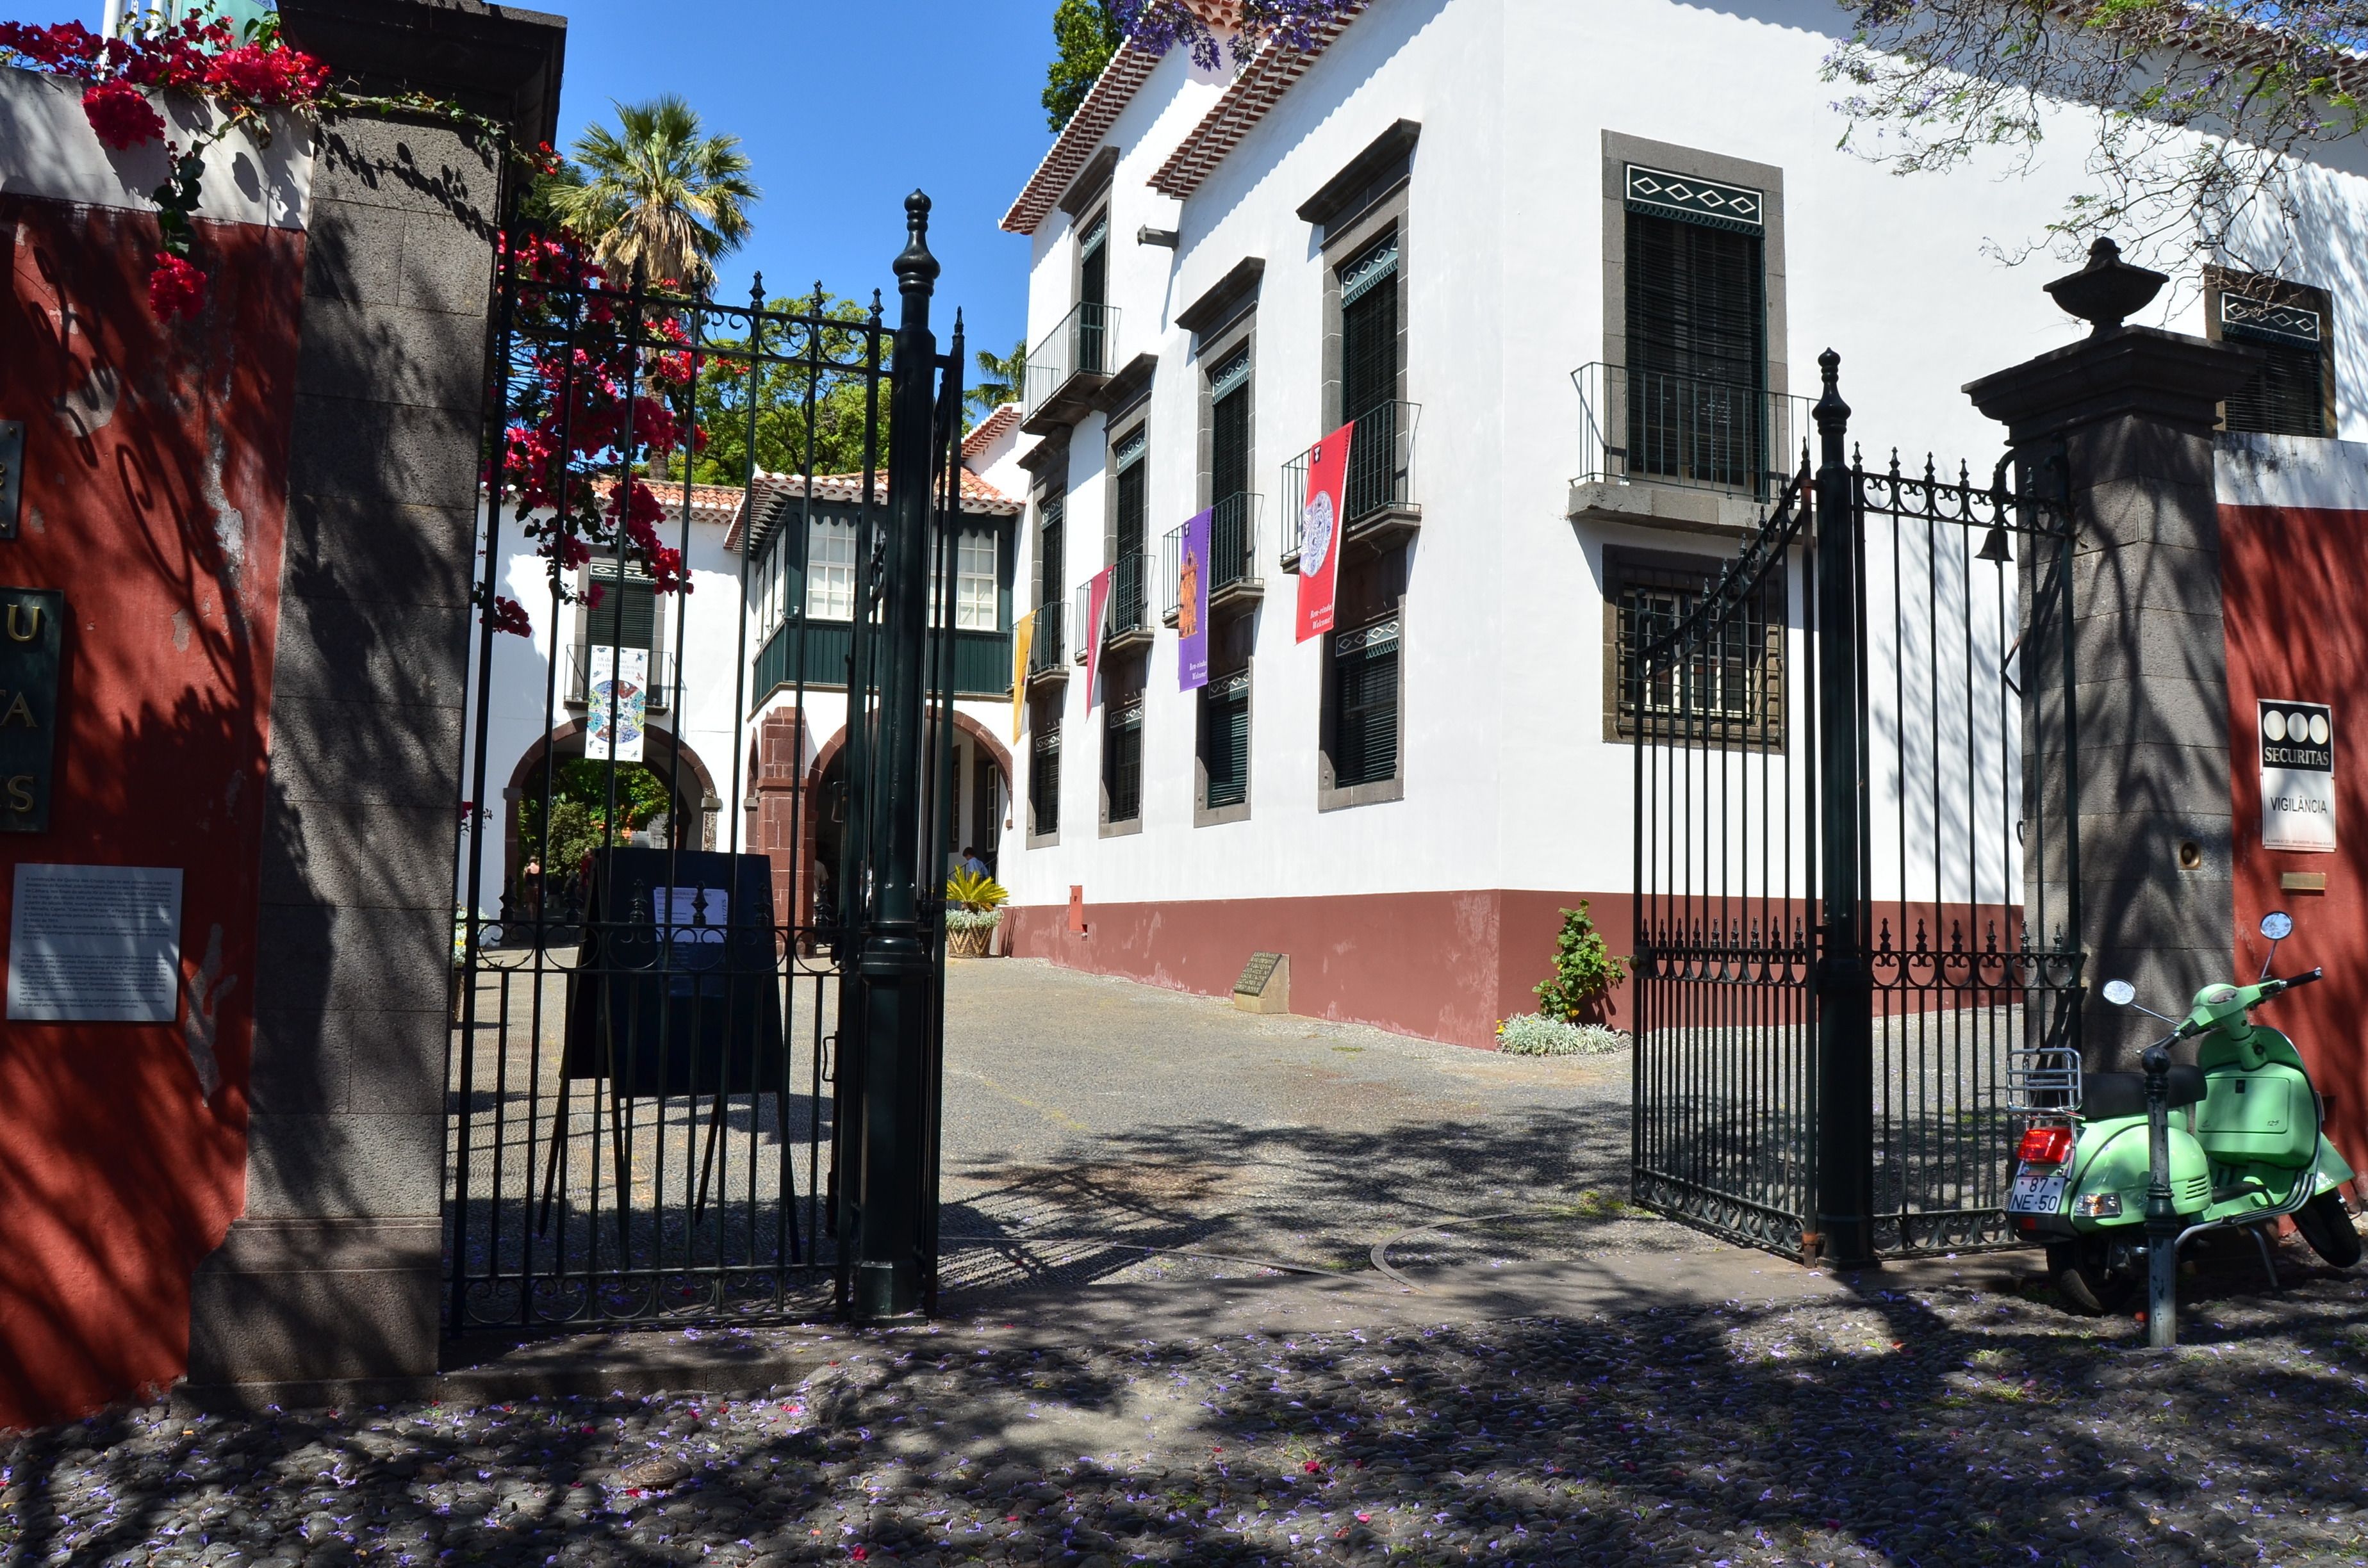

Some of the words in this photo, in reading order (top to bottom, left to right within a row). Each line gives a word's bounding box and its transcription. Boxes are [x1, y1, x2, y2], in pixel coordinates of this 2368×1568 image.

[2264, 747, 2330, 766] SECURITAS
[2270, 795, 2328, 814] VIGILÂNCIA
[2029, 1178, 2049, 1193] 87
